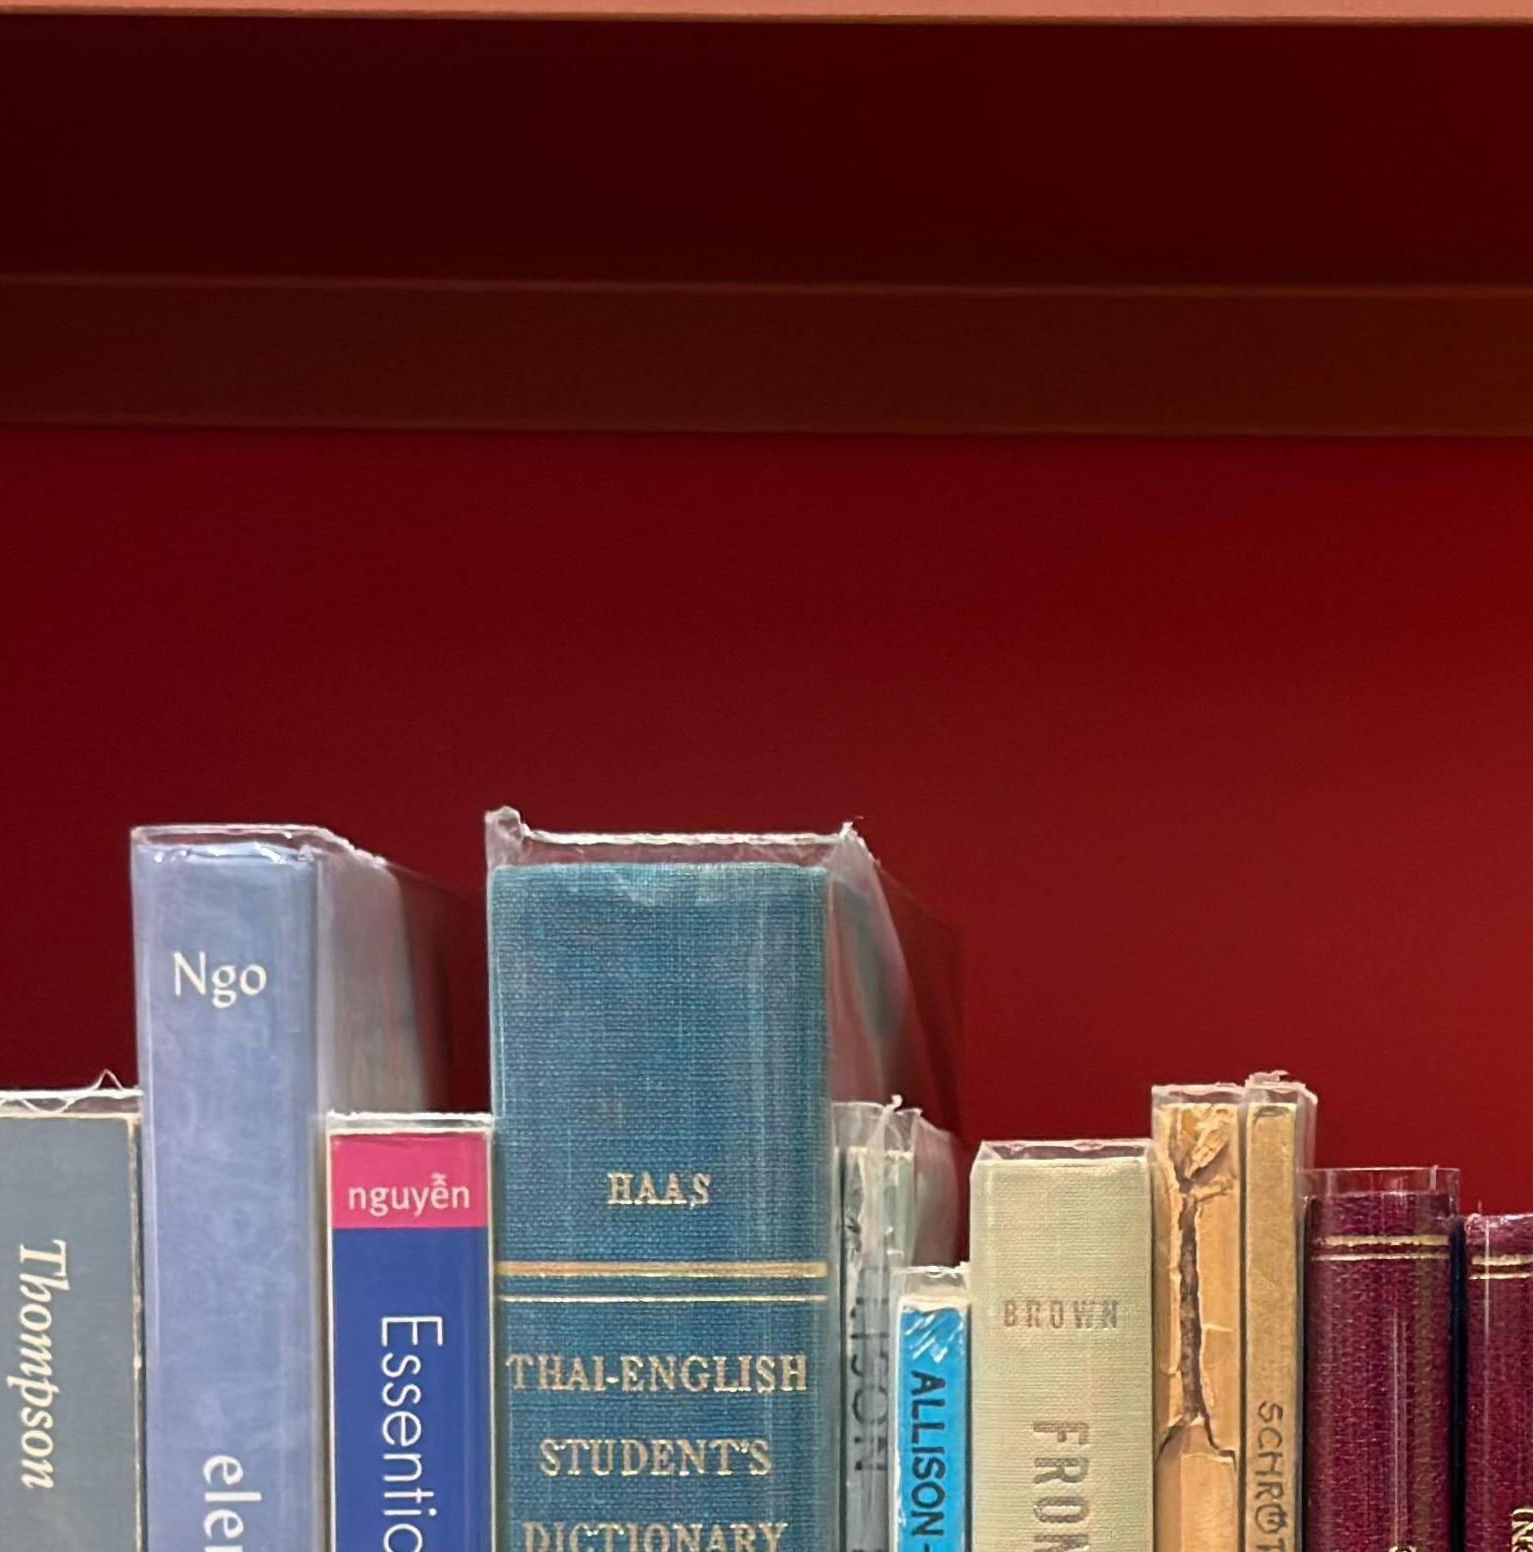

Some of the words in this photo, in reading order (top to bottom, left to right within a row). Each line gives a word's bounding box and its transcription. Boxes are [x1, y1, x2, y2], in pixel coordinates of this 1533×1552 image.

[172, 951, 268, 1009] Ngo
[347, 1173, 471, 1218] nguyễn
[606, 1171, 712, 1208] HAAS
[1003, 1299, 1119, 1330] BROWN
[6, 1238, 70, 1490] Thompson
[505, 1354, 808, 1393] THAI-ENGLISH
[538, 1439, 773, 1477] STUDENT'S
